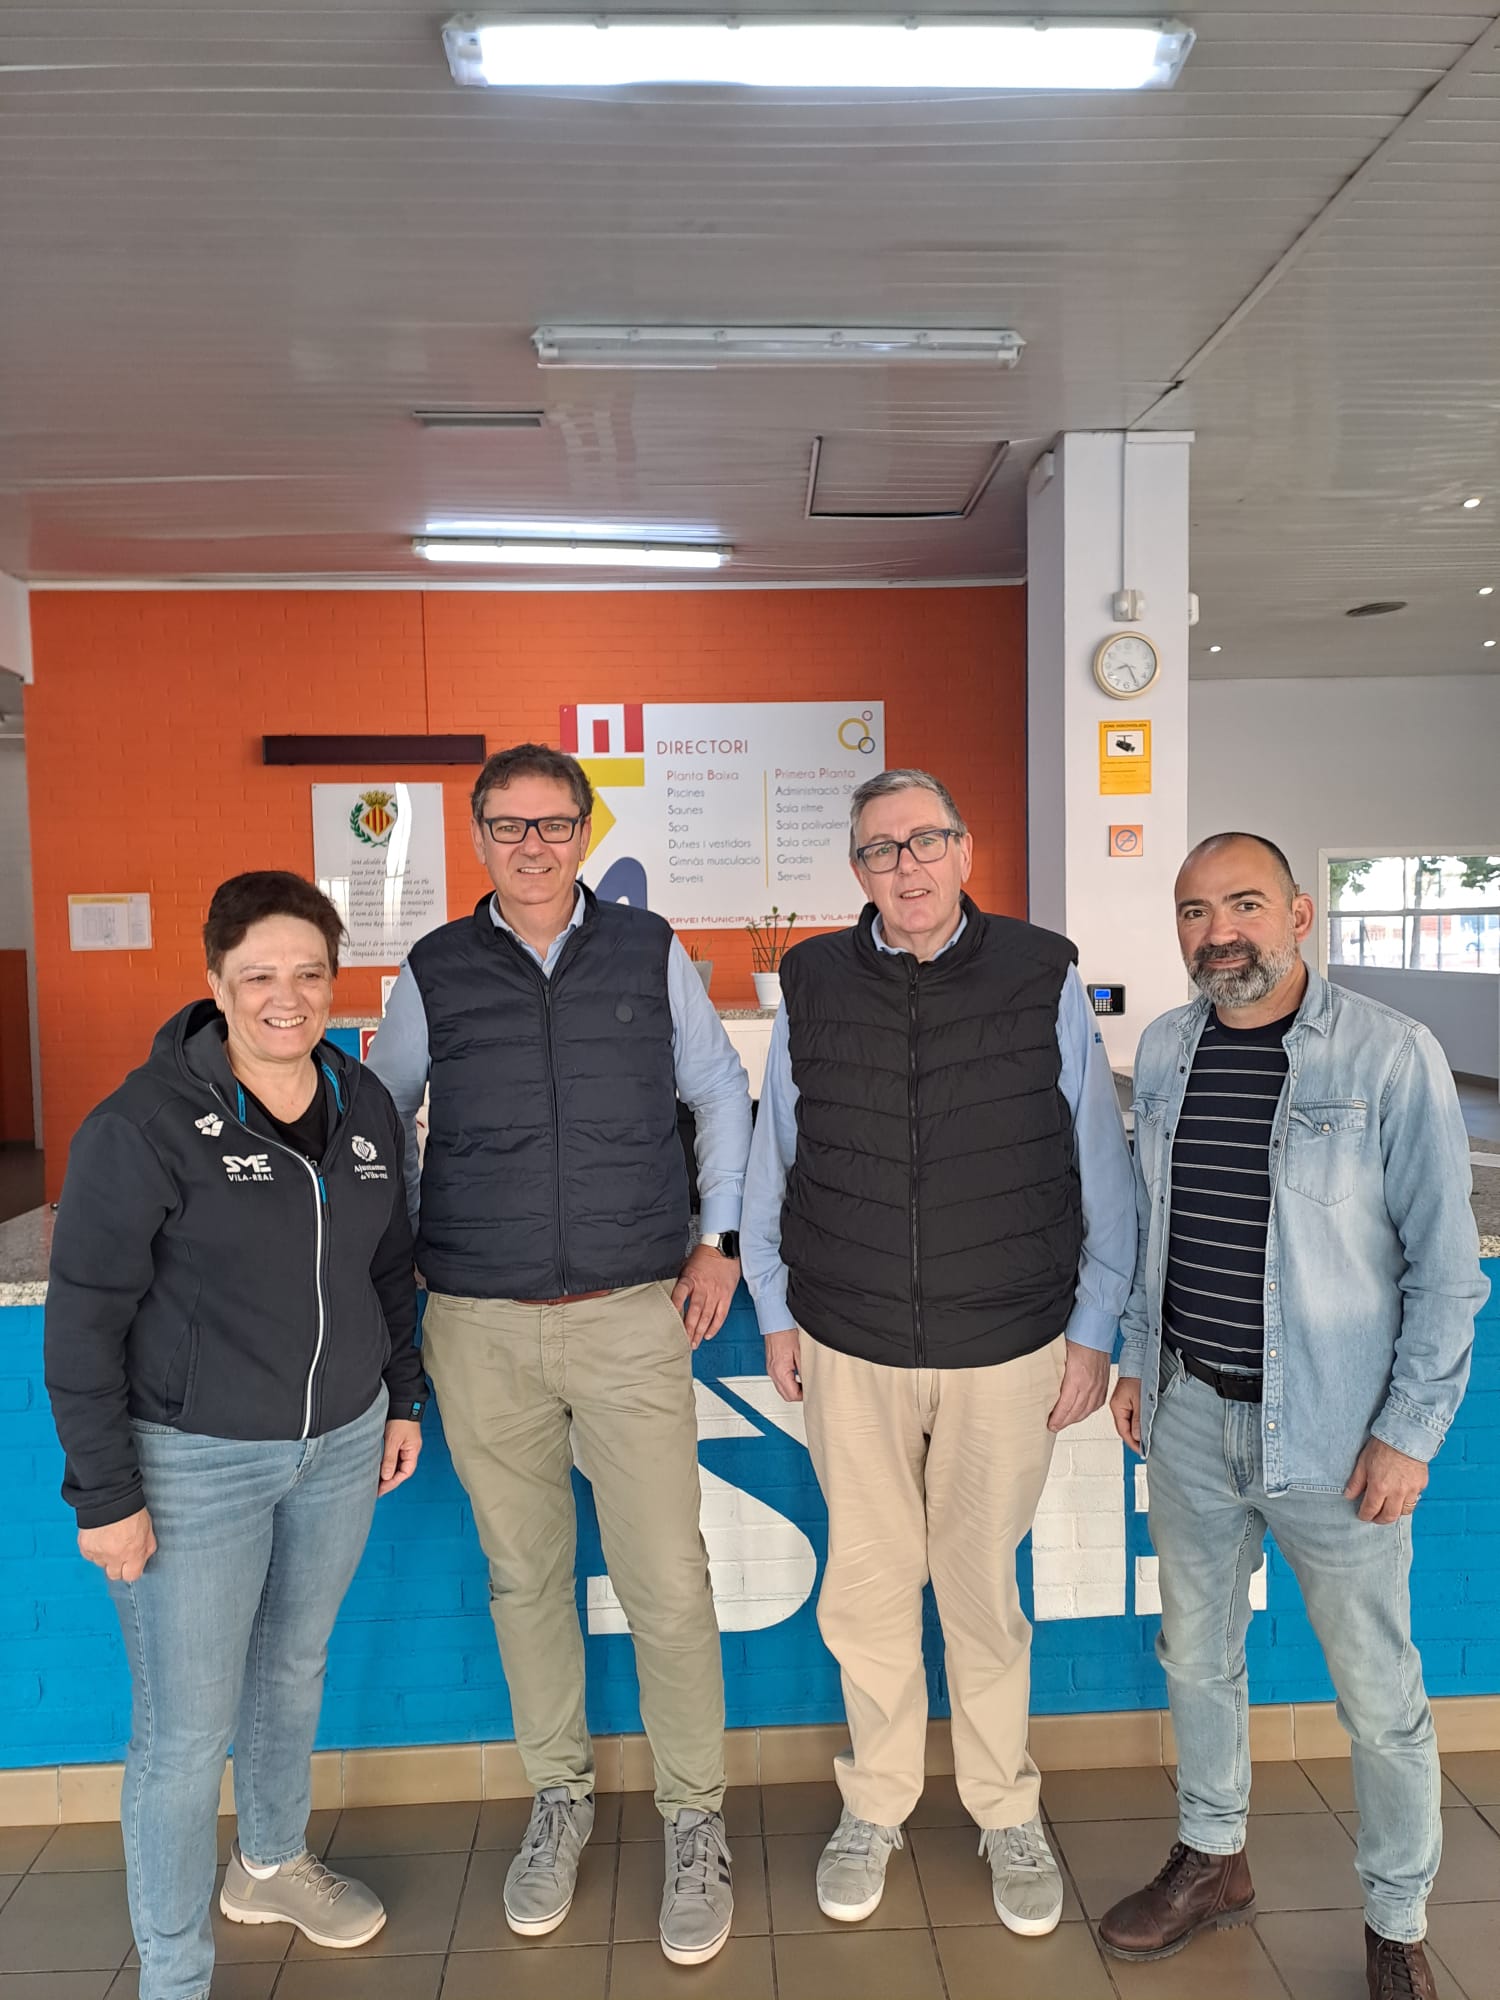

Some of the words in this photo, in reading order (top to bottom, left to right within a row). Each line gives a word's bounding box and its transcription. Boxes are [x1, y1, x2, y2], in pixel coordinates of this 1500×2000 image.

[656, 740, 748, 755] DIRECTORI
[666, 770, 704, 781] Planta
[707, 769, 739, 781] Baixa
[775, 768, 816, 779] Primera
[819, 767, 856, 779] Planta
[667, 787, 705, 798] Piscines
[667, 804, 704, 815] Saunes
[776, 802, 799, 813] Sala
[668, 821, 689, 834] Spa
[776, 819, 799, 830] Sala
[668, 839, 700, 849] Dutxes
[707, 838, 752, 849] vestidors
[776, 837, 800, 847] Sala
[801, 837, 831, 847] circuit
[777, 854, 813, 864] Grades
[669, 872, 704, 883] Serveis
[777, 871, 811, 881] Serveis
[701, 915, 757, 924] MUNICIPAL
[222, 1153, 272, 1173] SME
[227, 1173, 274, 1182] VILA-REAL
